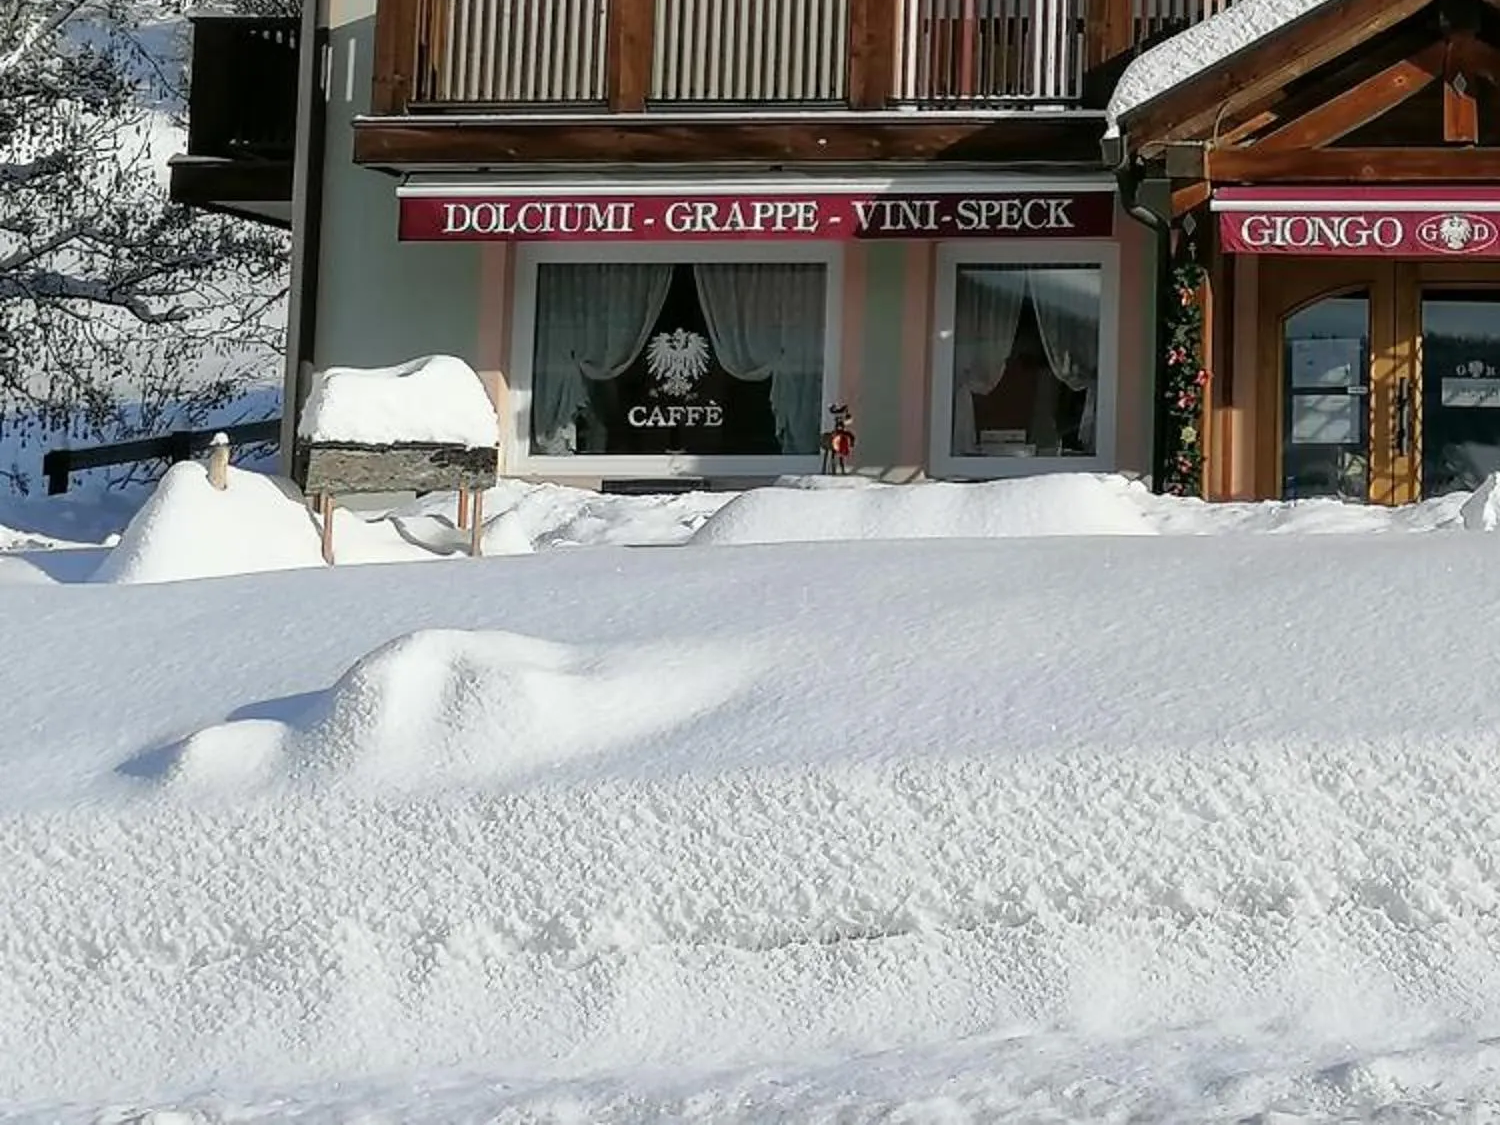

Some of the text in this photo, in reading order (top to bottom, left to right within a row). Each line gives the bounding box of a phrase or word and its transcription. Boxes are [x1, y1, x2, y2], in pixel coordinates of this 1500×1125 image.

[443, 202, 635, 234] DOLCIUMI
[665, 200, 820, 233] GRAPPE
[1241, 215, 1404, 248] GIONGO
[627, 399, 724, 428] CAFFÈ
